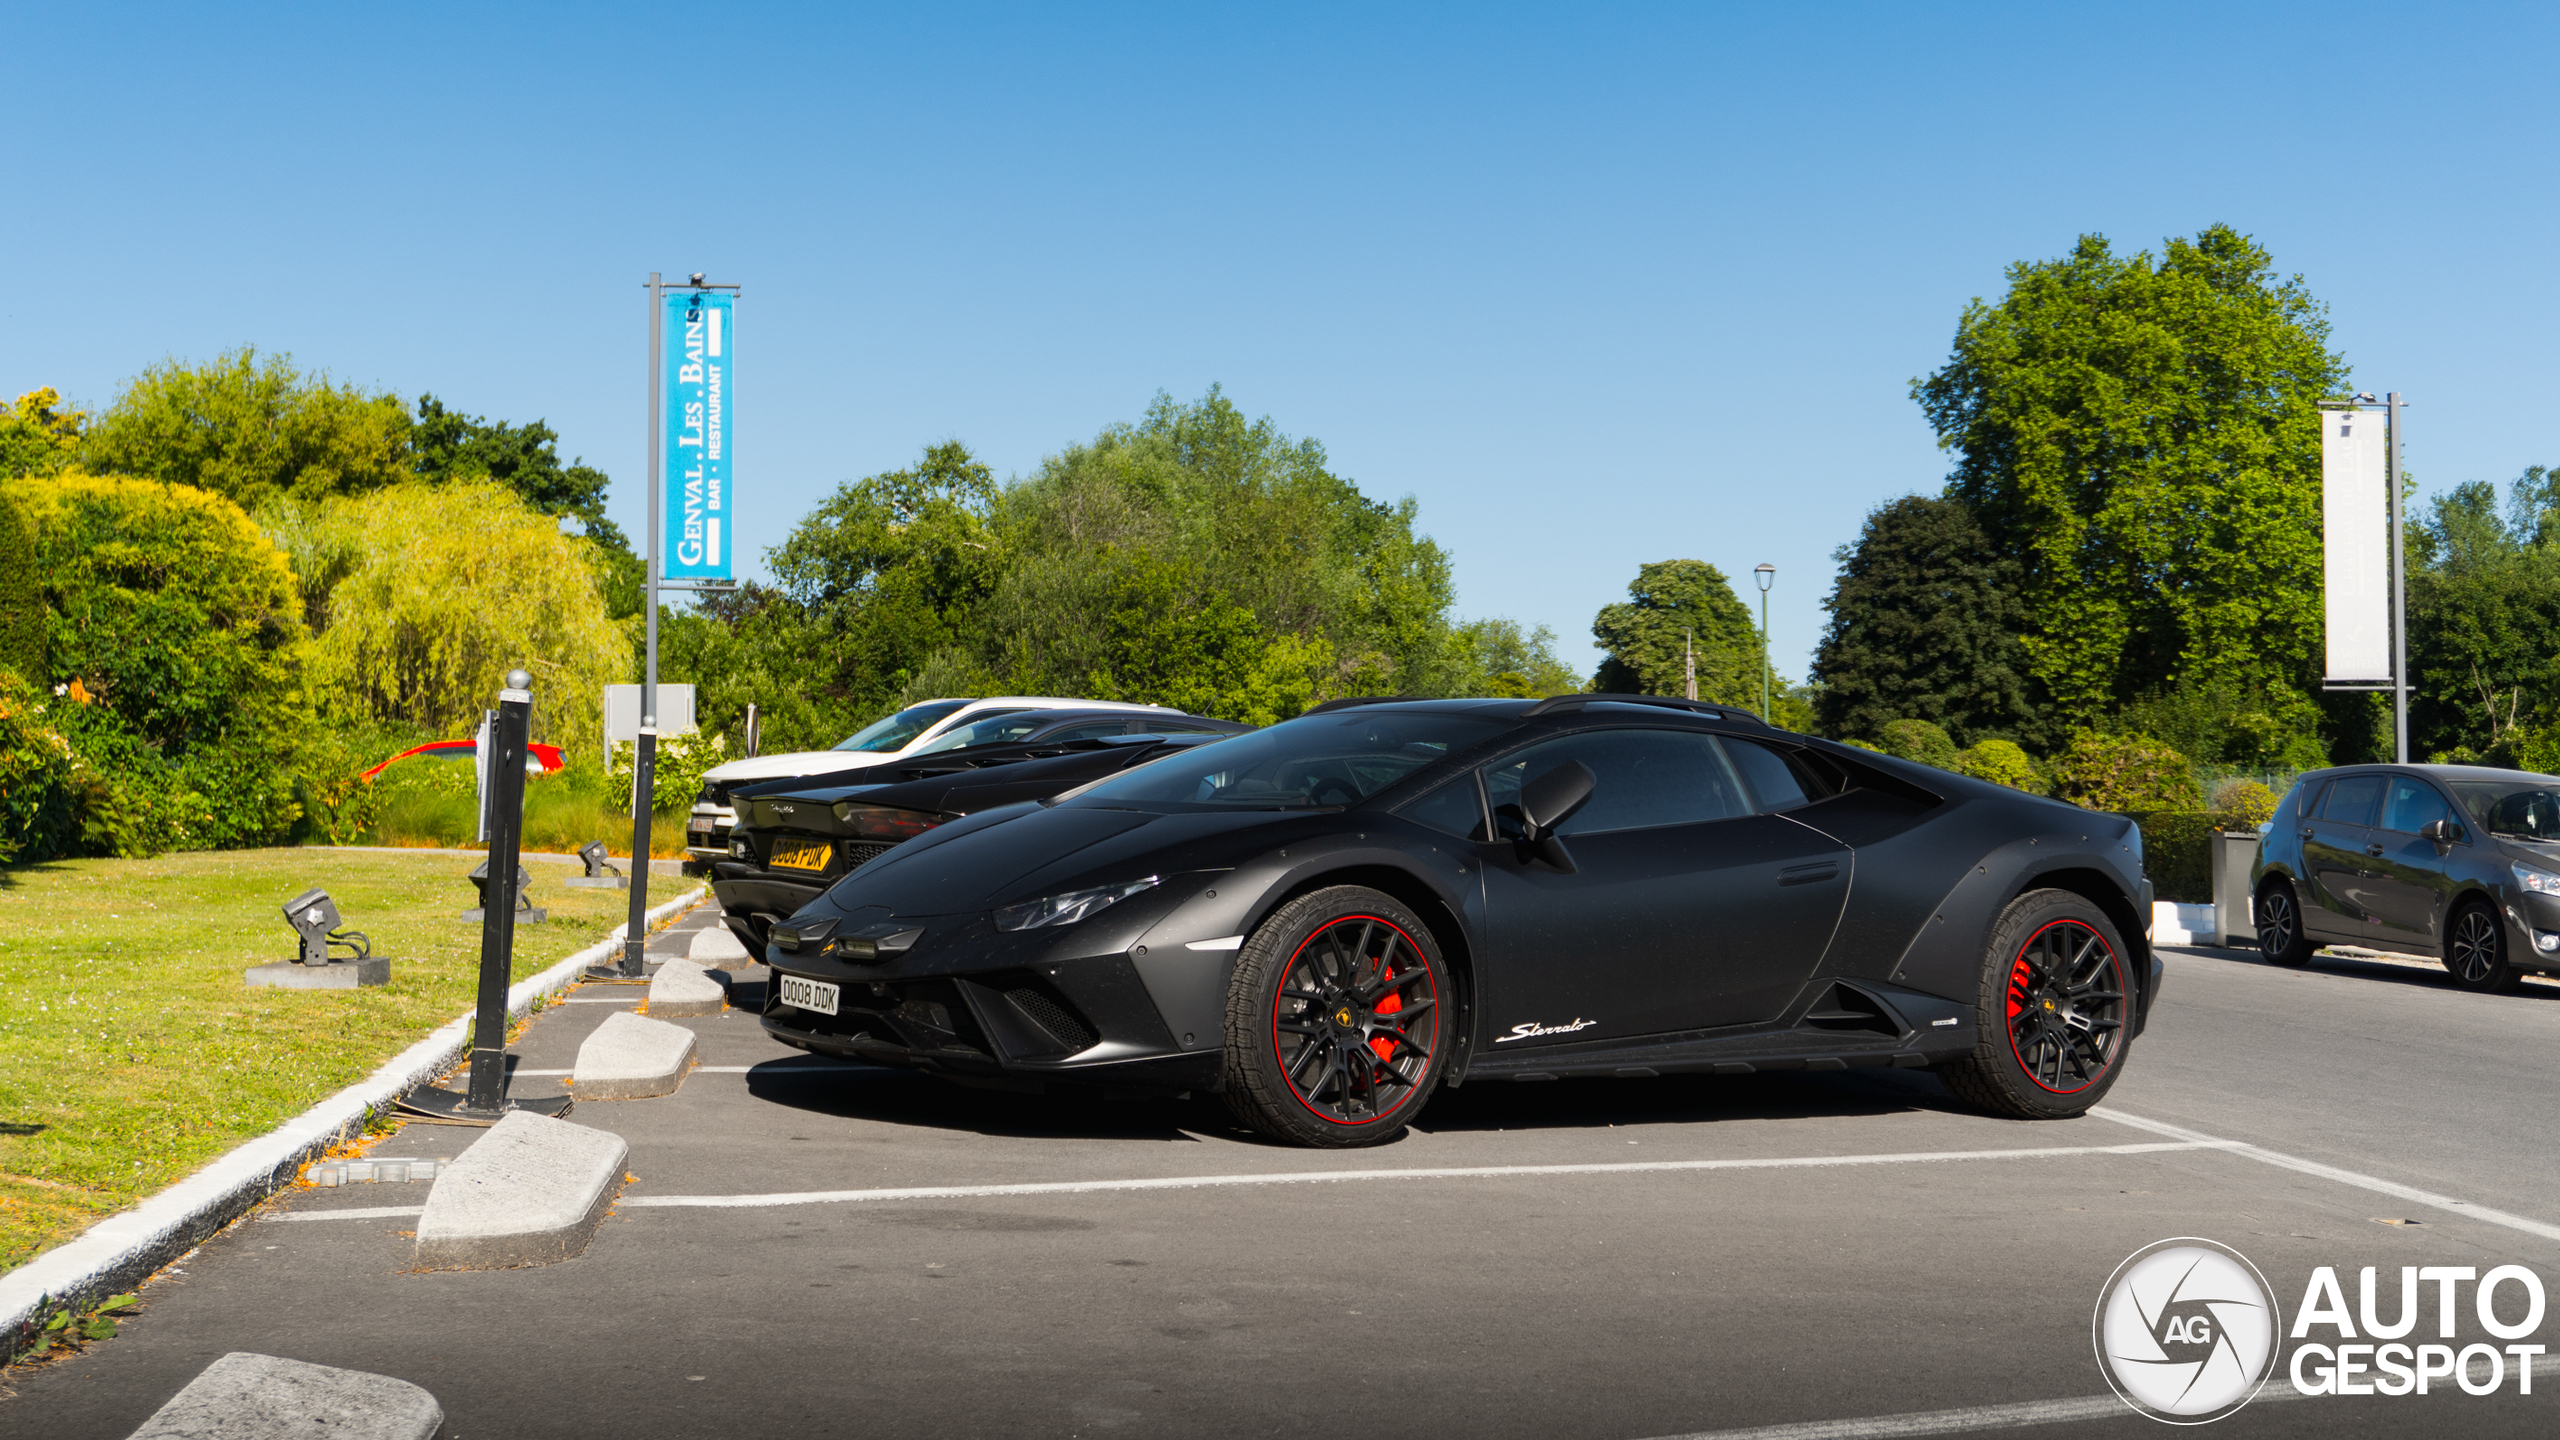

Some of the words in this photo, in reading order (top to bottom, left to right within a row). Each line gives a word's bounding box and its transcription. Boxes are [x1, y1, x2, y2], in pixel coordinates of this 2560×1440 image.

[708, 364, 721, 460] RESTAURANT
[708, 479, 721, 510] BAR
[799, 843, 827, 868] PDK
[814, 985, 836, 1011] DDK
[1495, 1017, 1597, 1043] Sterrato
